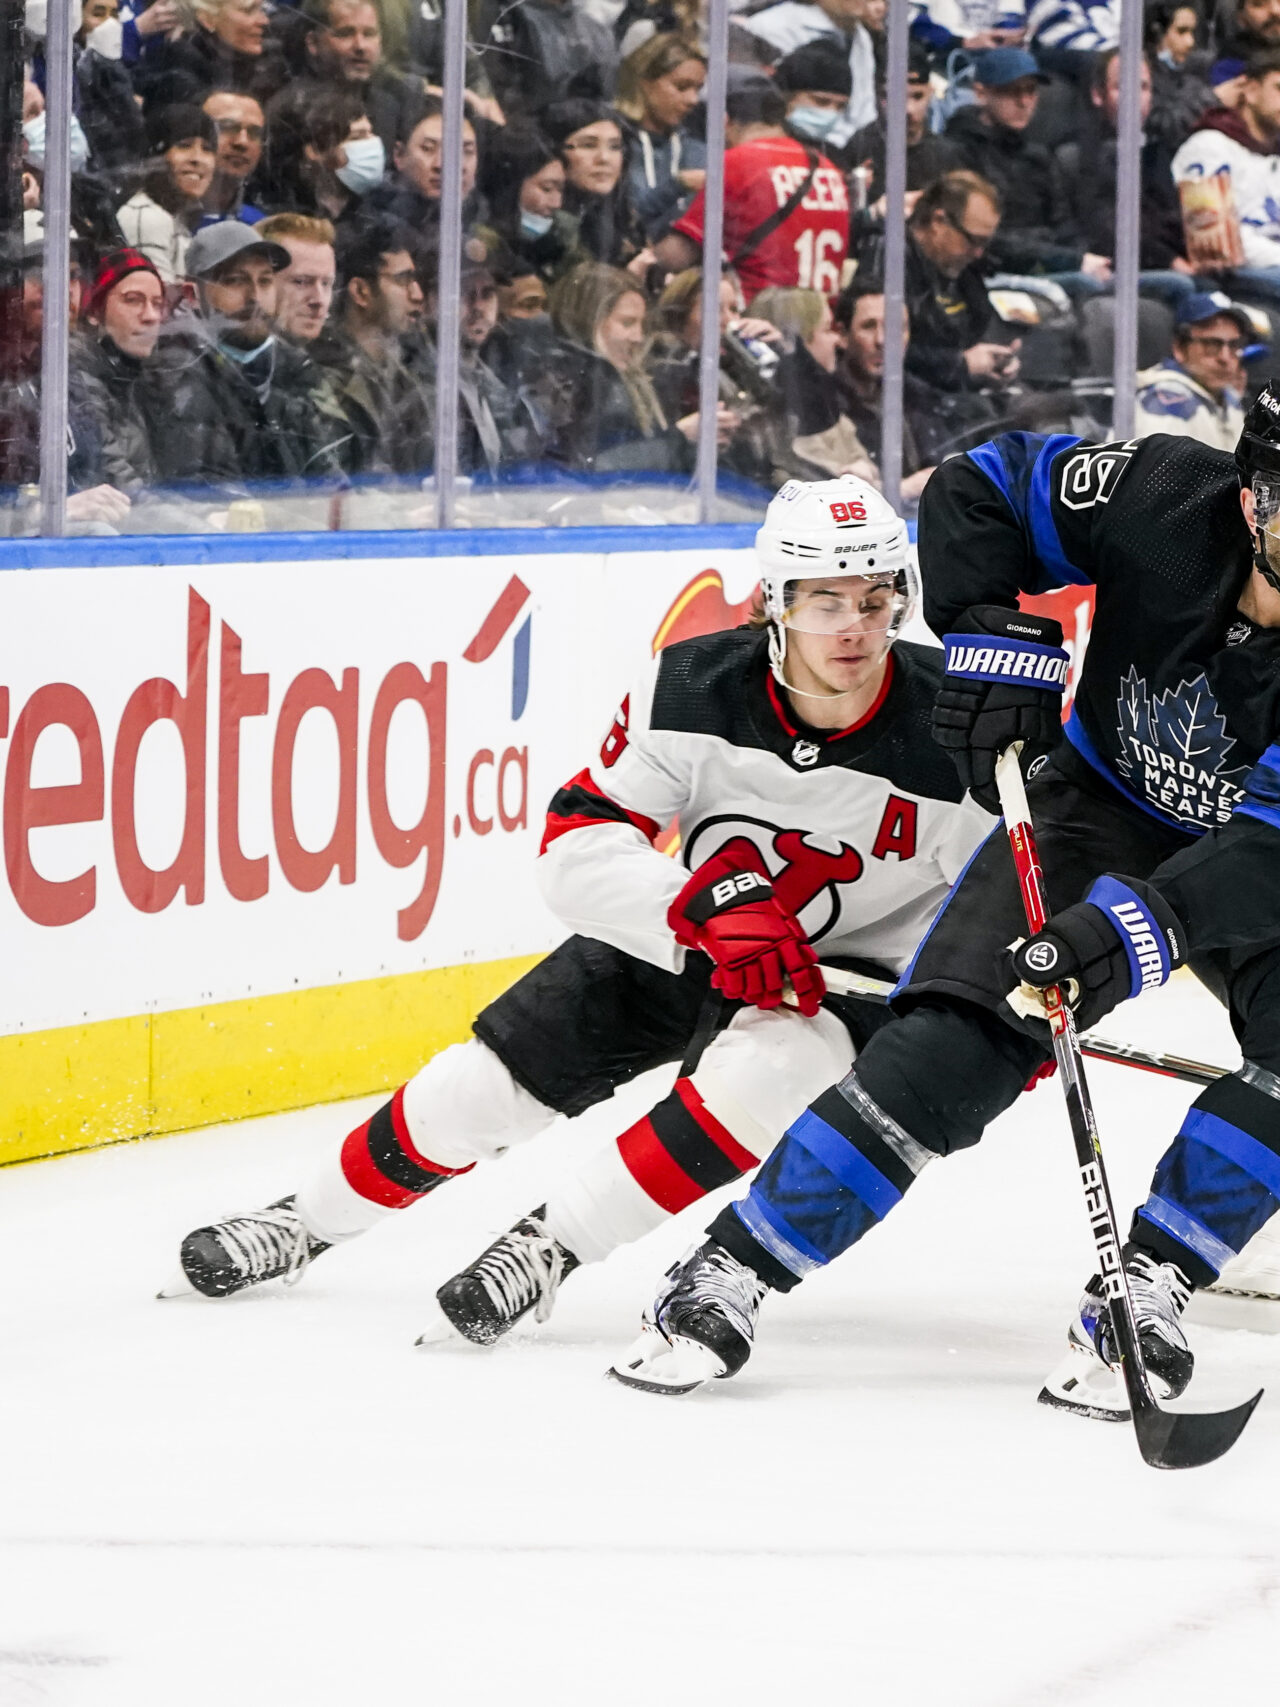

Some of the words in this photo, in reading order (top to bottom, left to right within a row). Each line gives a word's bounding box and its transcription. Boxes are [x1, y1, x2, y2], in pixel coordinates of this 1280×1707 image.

[794, 228, 843, 297] 16
[829, 501, 867, 522] 86
[834, 543, 878, 554] BAUER
[1006, 623, 1042, 636] GIORDANO
[947, 646, 1069, 685] WARRIOR
[1144, 764, 1232, 812] MAPLE
[1144, 780, 1232, 823] LEAFS
[871, 793, 917, 862] A
[1166, 927, 1179, 960] GIORDANO
[1079, 1161, 1127, 1300] BAUER
